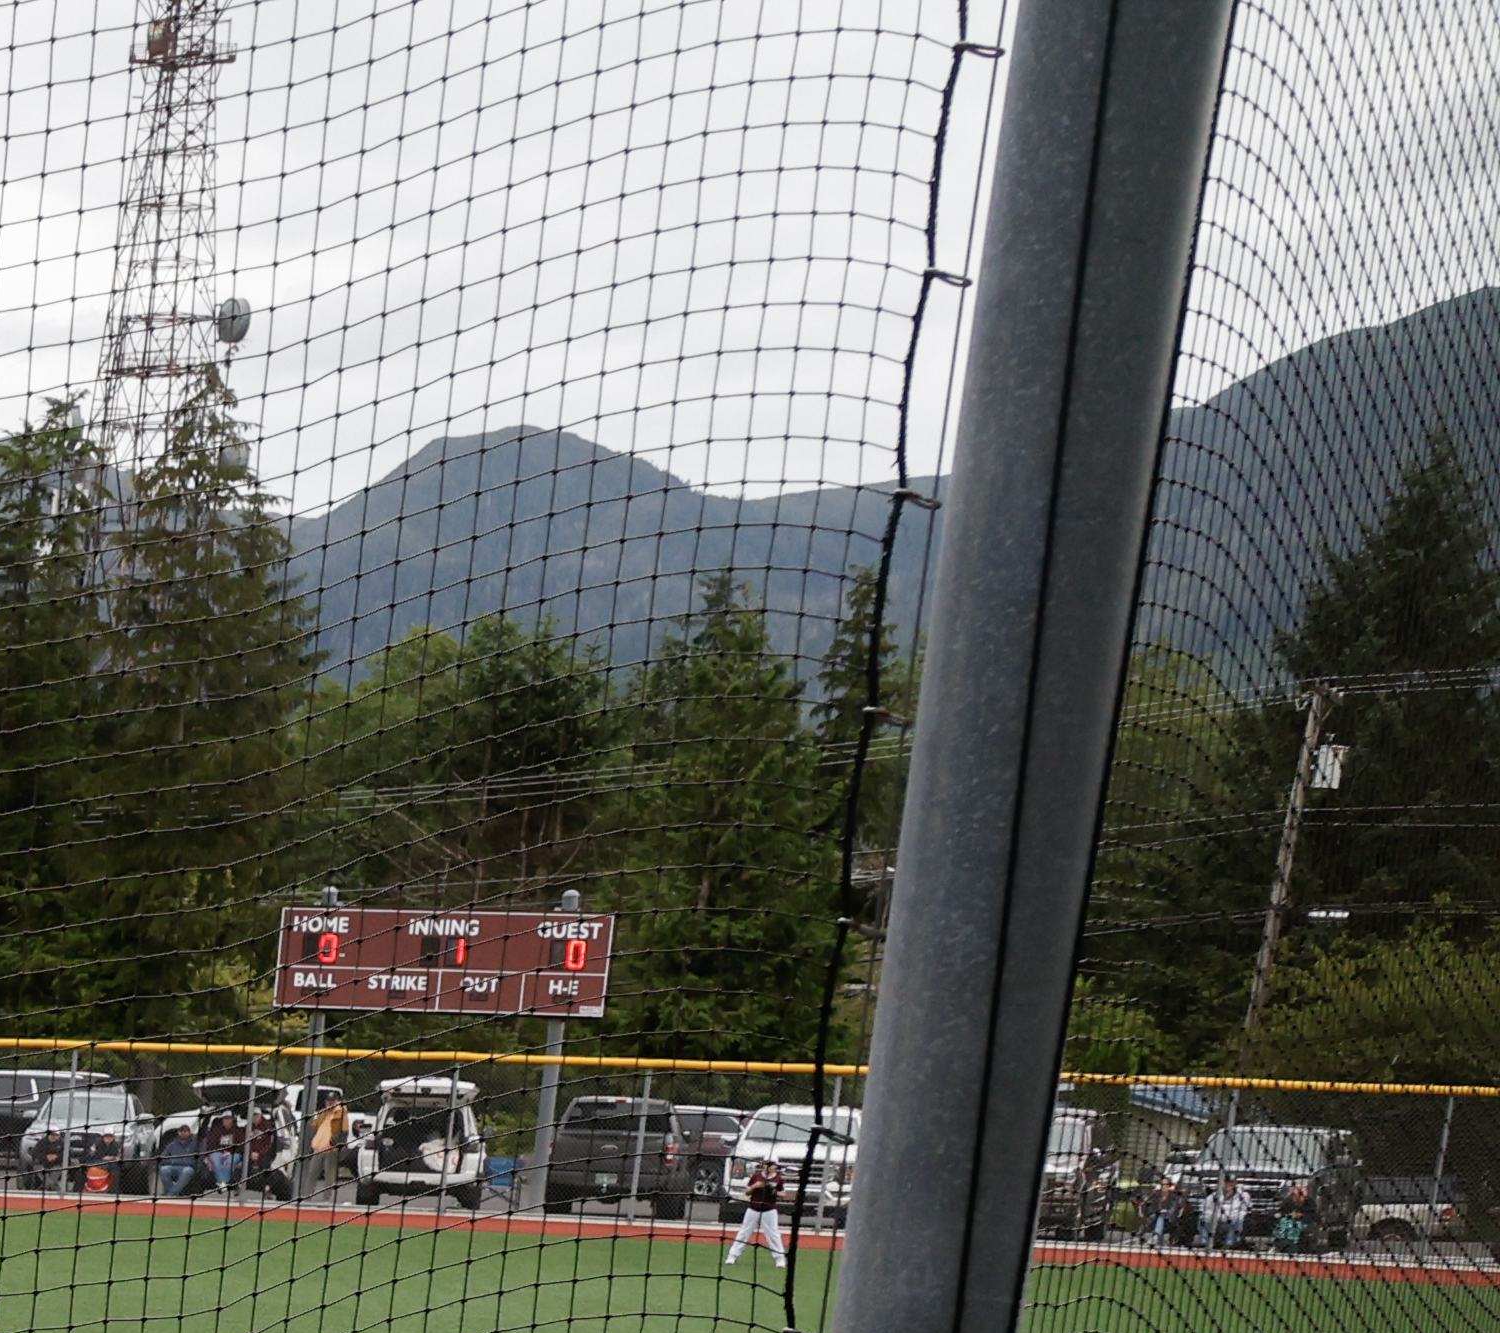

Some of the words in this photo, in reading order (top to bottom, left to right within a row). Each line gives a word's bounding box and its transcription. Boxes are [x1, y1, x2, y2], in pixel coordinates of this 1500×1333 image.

[293, 915, 350, 934] HOME
[408, 918, 481, 937] INNING
[537, 921, 603, 940] GUEST
[318, 933, 340, 964] 0
[455, 939, 467, 965] 1
[565, 940, 588, 971] 0
[293, 972, 337, 989] BALL
[367, 975, 428, 992] STRIKE
[460, 977, 500, 994] OUT
[548, 979, 580, 996] H-E
